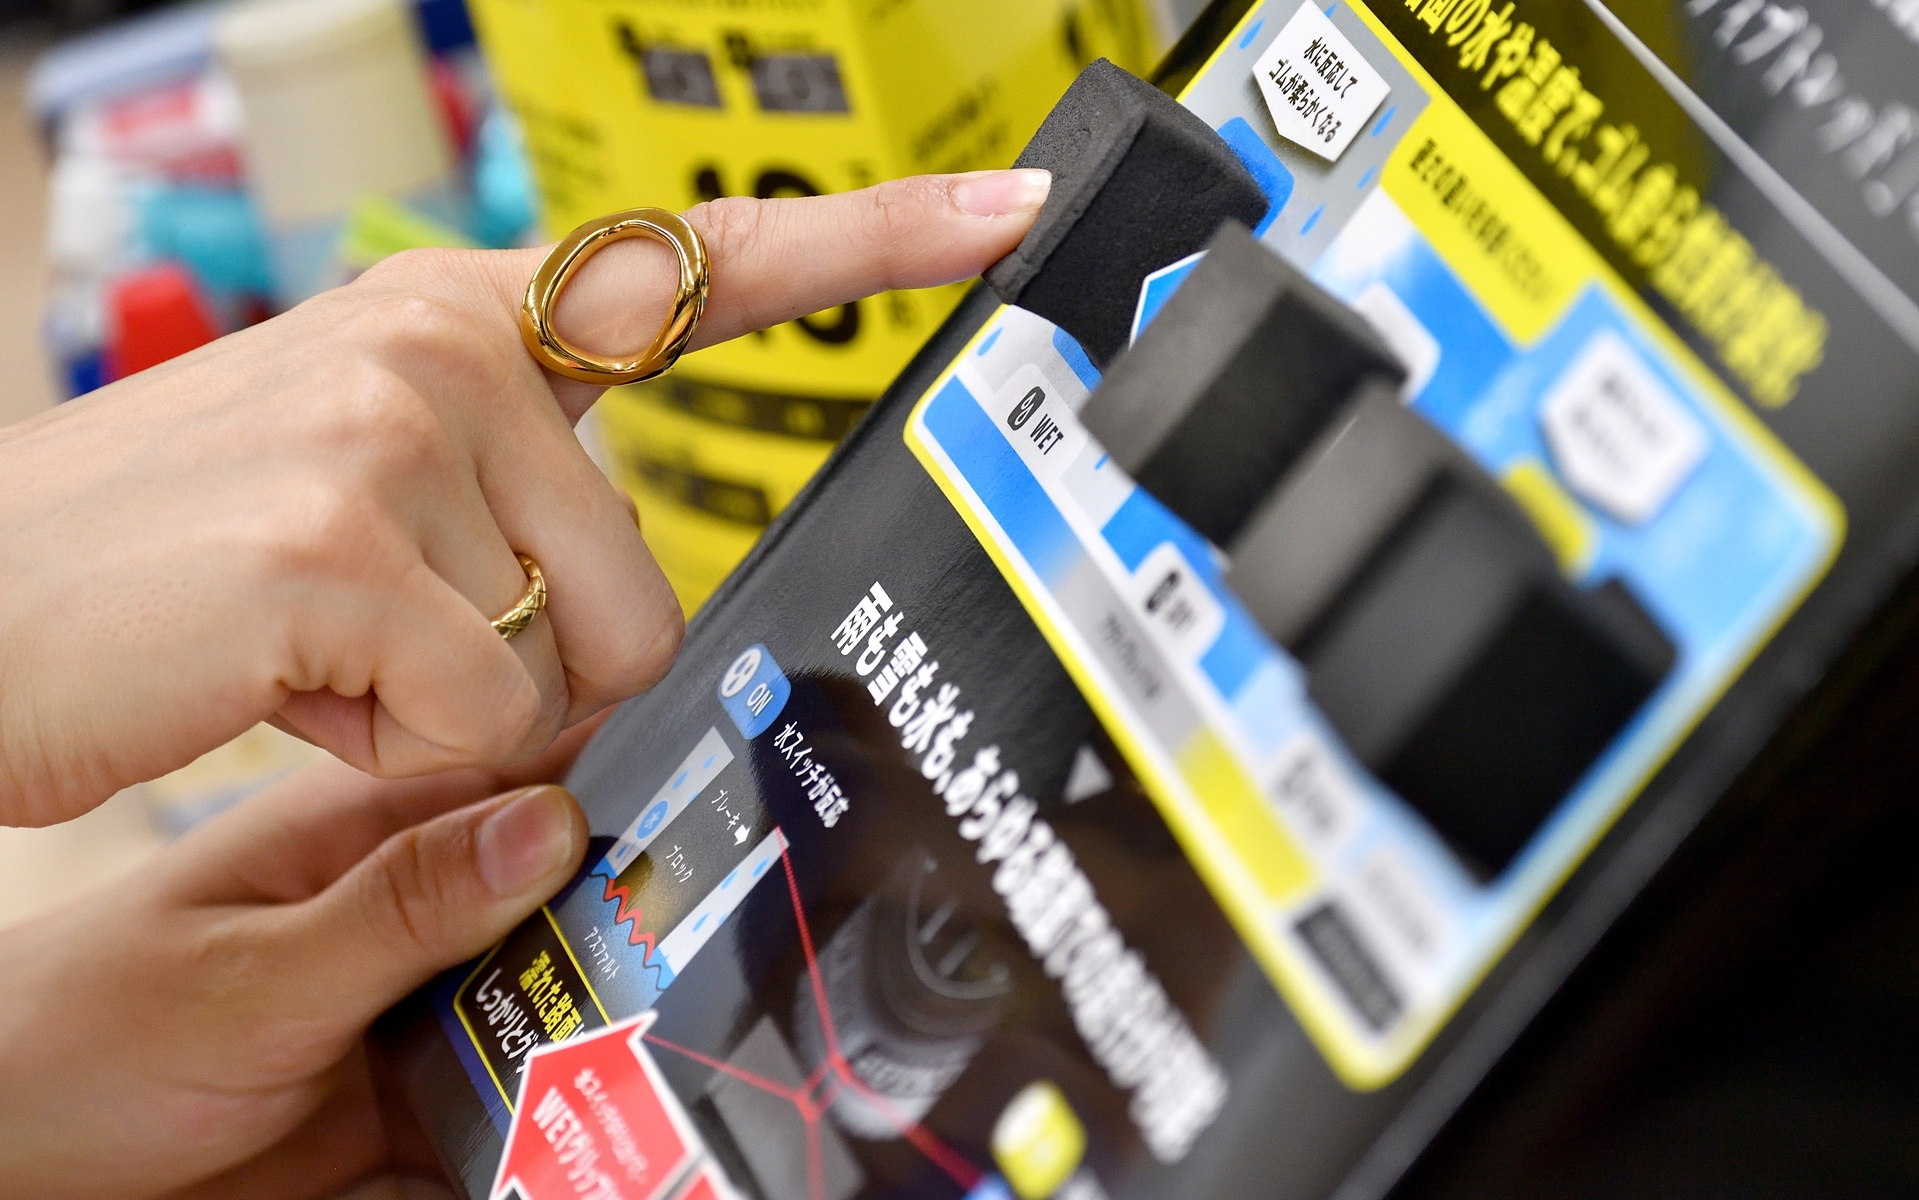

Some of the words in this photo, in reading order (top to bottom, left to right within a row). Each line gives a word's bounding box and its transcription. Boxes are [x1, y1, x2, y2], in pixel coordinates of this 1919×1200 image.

[1303, 36, 1358, 99] 水に反応して
[1268, 59, 1342, 143] ゴムが柔らかくなる
[1029, 413, 1064, 455] WET
[746, 683, 773, 716] ON
[773, 721, 849, 829] 水スイッチが反応
[711, 789, 740, 830] ブレーキ
[666, 845, 693, 883] ブロック
[584, 926, 619, 981] アスファルト
